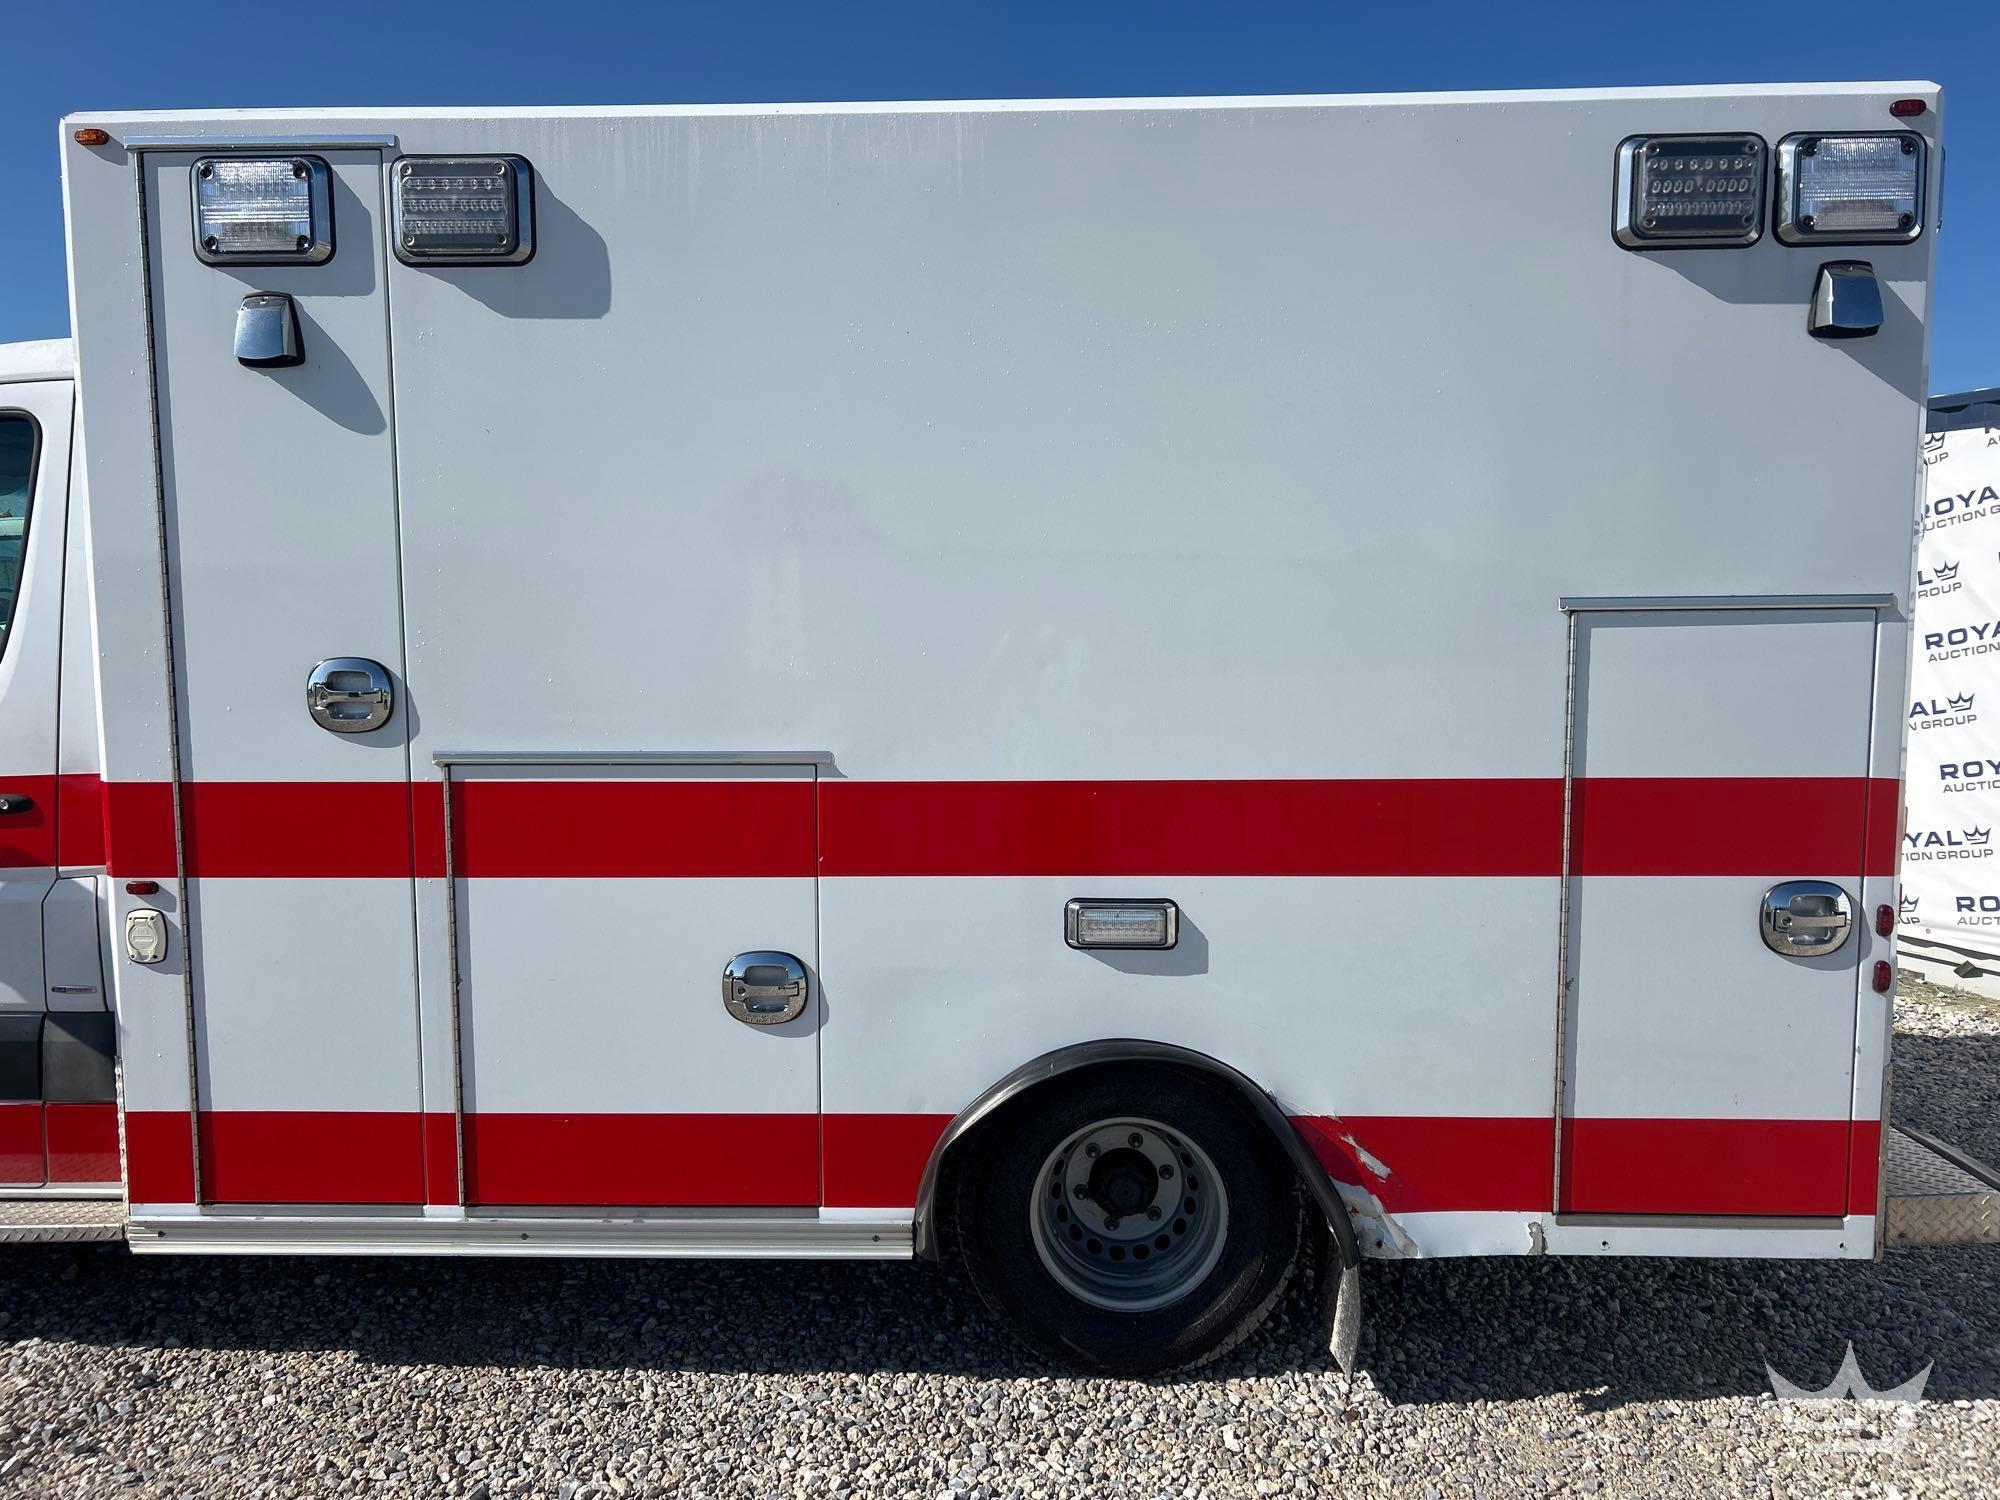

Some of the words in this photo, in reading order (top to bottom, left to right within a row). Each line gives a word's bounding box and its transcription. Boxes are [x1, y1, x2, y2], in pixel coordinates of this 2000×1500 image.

[1925, 486, 2000, 519] OYA
[1924, 508, 1986, 531] UCTION
[1918, 582, 1962, 599] ROUP
[1925, 621, 2000, 650] ROY
[1928, 642, 2000, 663] AUCTION
[1921, 714, 1977, 730] GROUP
[1940, 760, 2000, 780] ROY
[1943, 780, 2000, 793] AUCTIO
[1905, 830, 1963, 848] YAL
[1936, 849, 1993, 860] GROUP
[1957, 916, 2000, 925] AUCT
